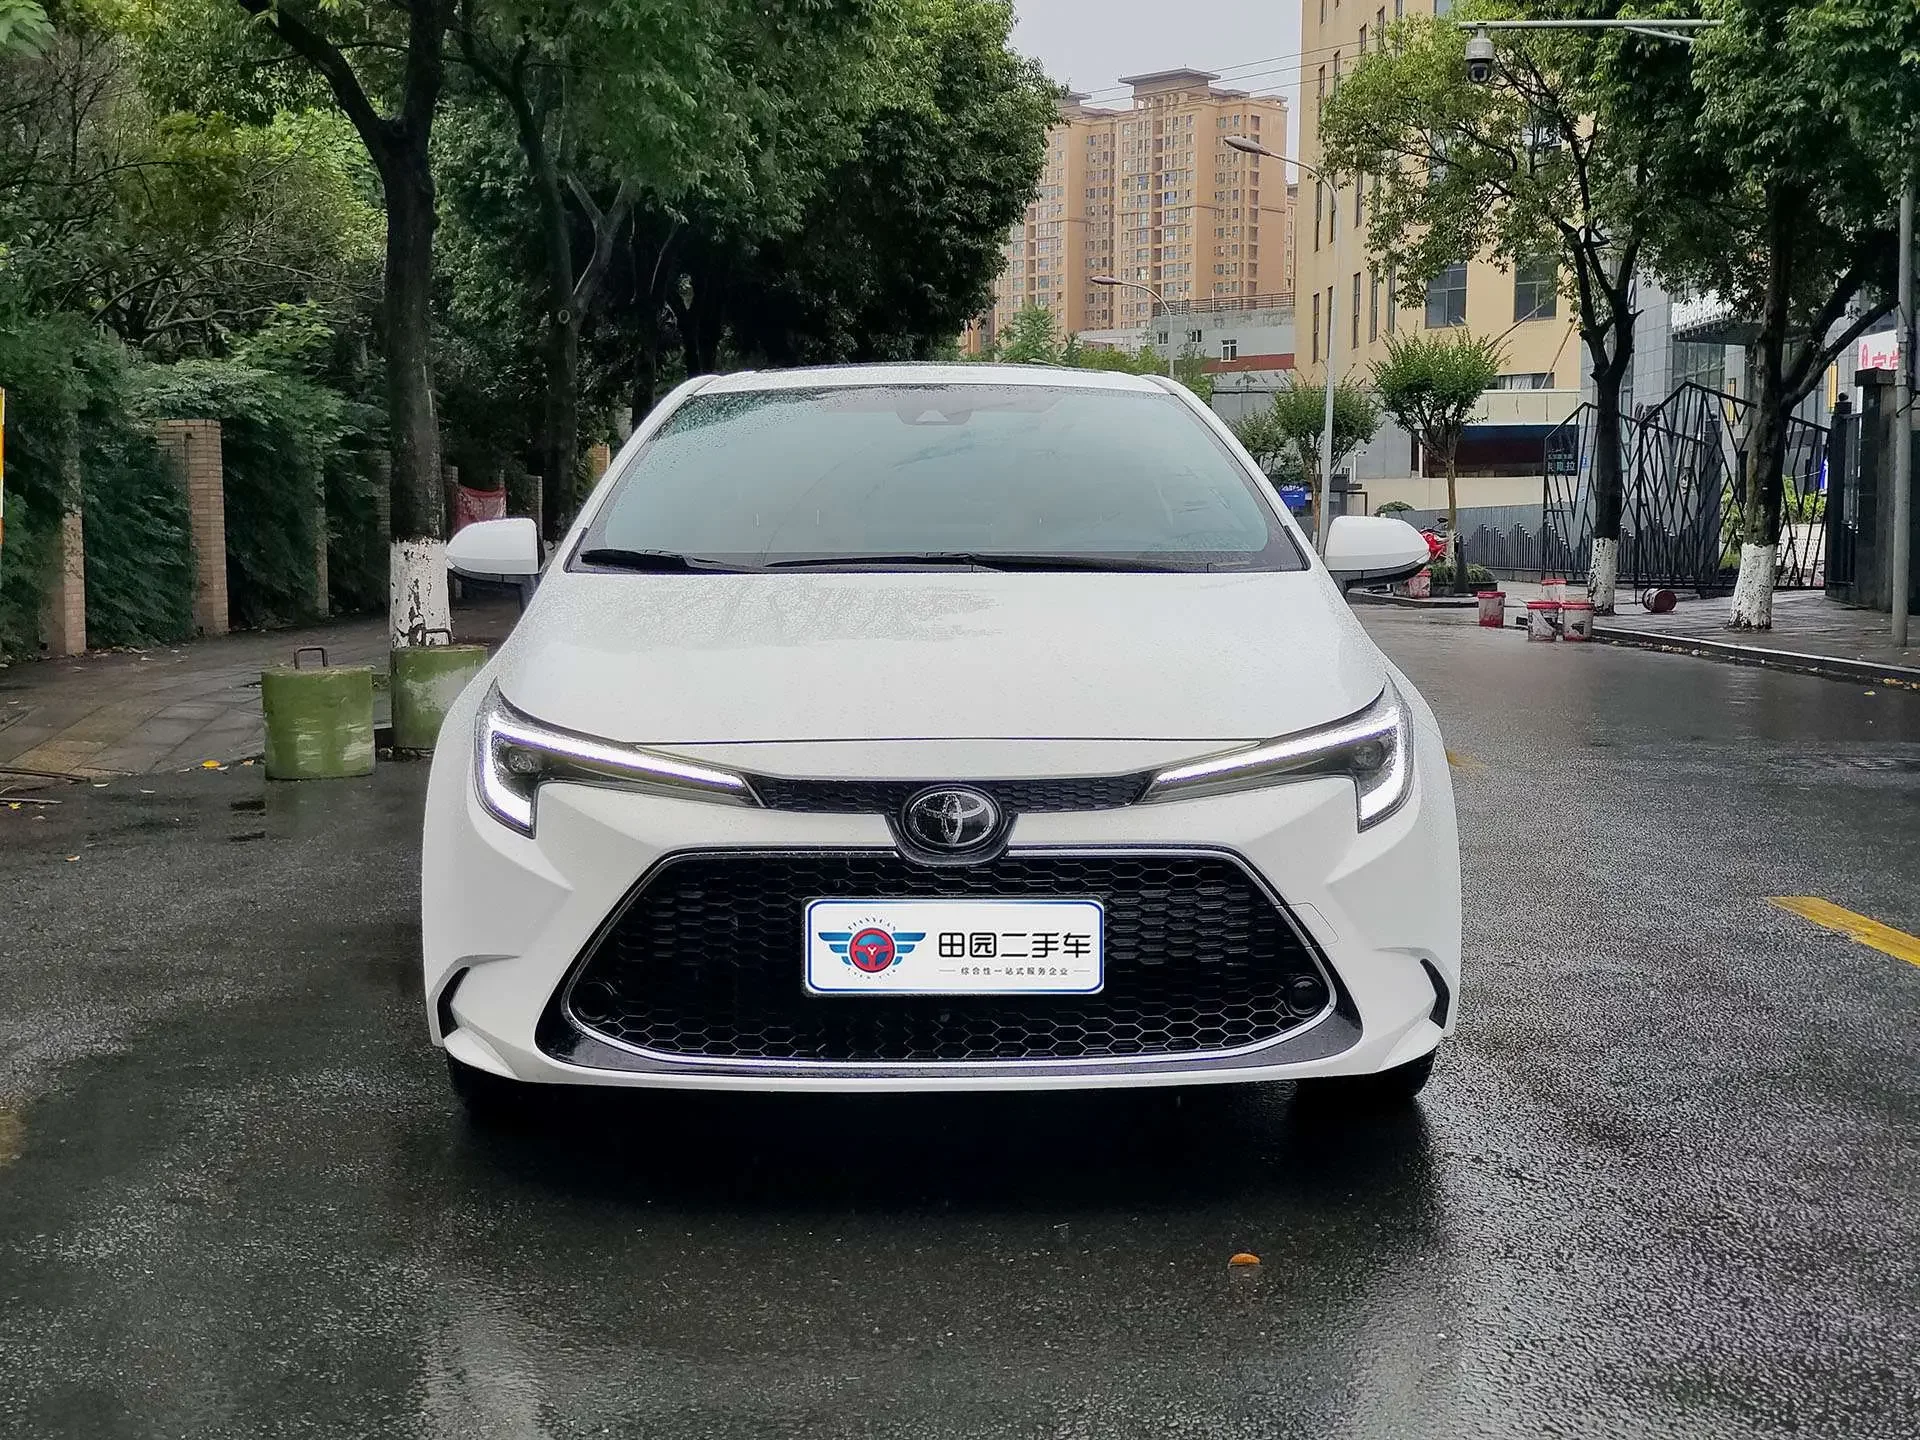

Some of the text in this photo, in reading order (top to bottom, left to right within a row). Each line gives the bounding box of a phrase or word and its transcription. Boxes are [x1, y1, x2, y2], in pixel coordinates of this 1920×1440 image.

[938, 932, 1091, 959] 田园二手车
[960, 966, 1069, 976] 综合性一站式服务企业
